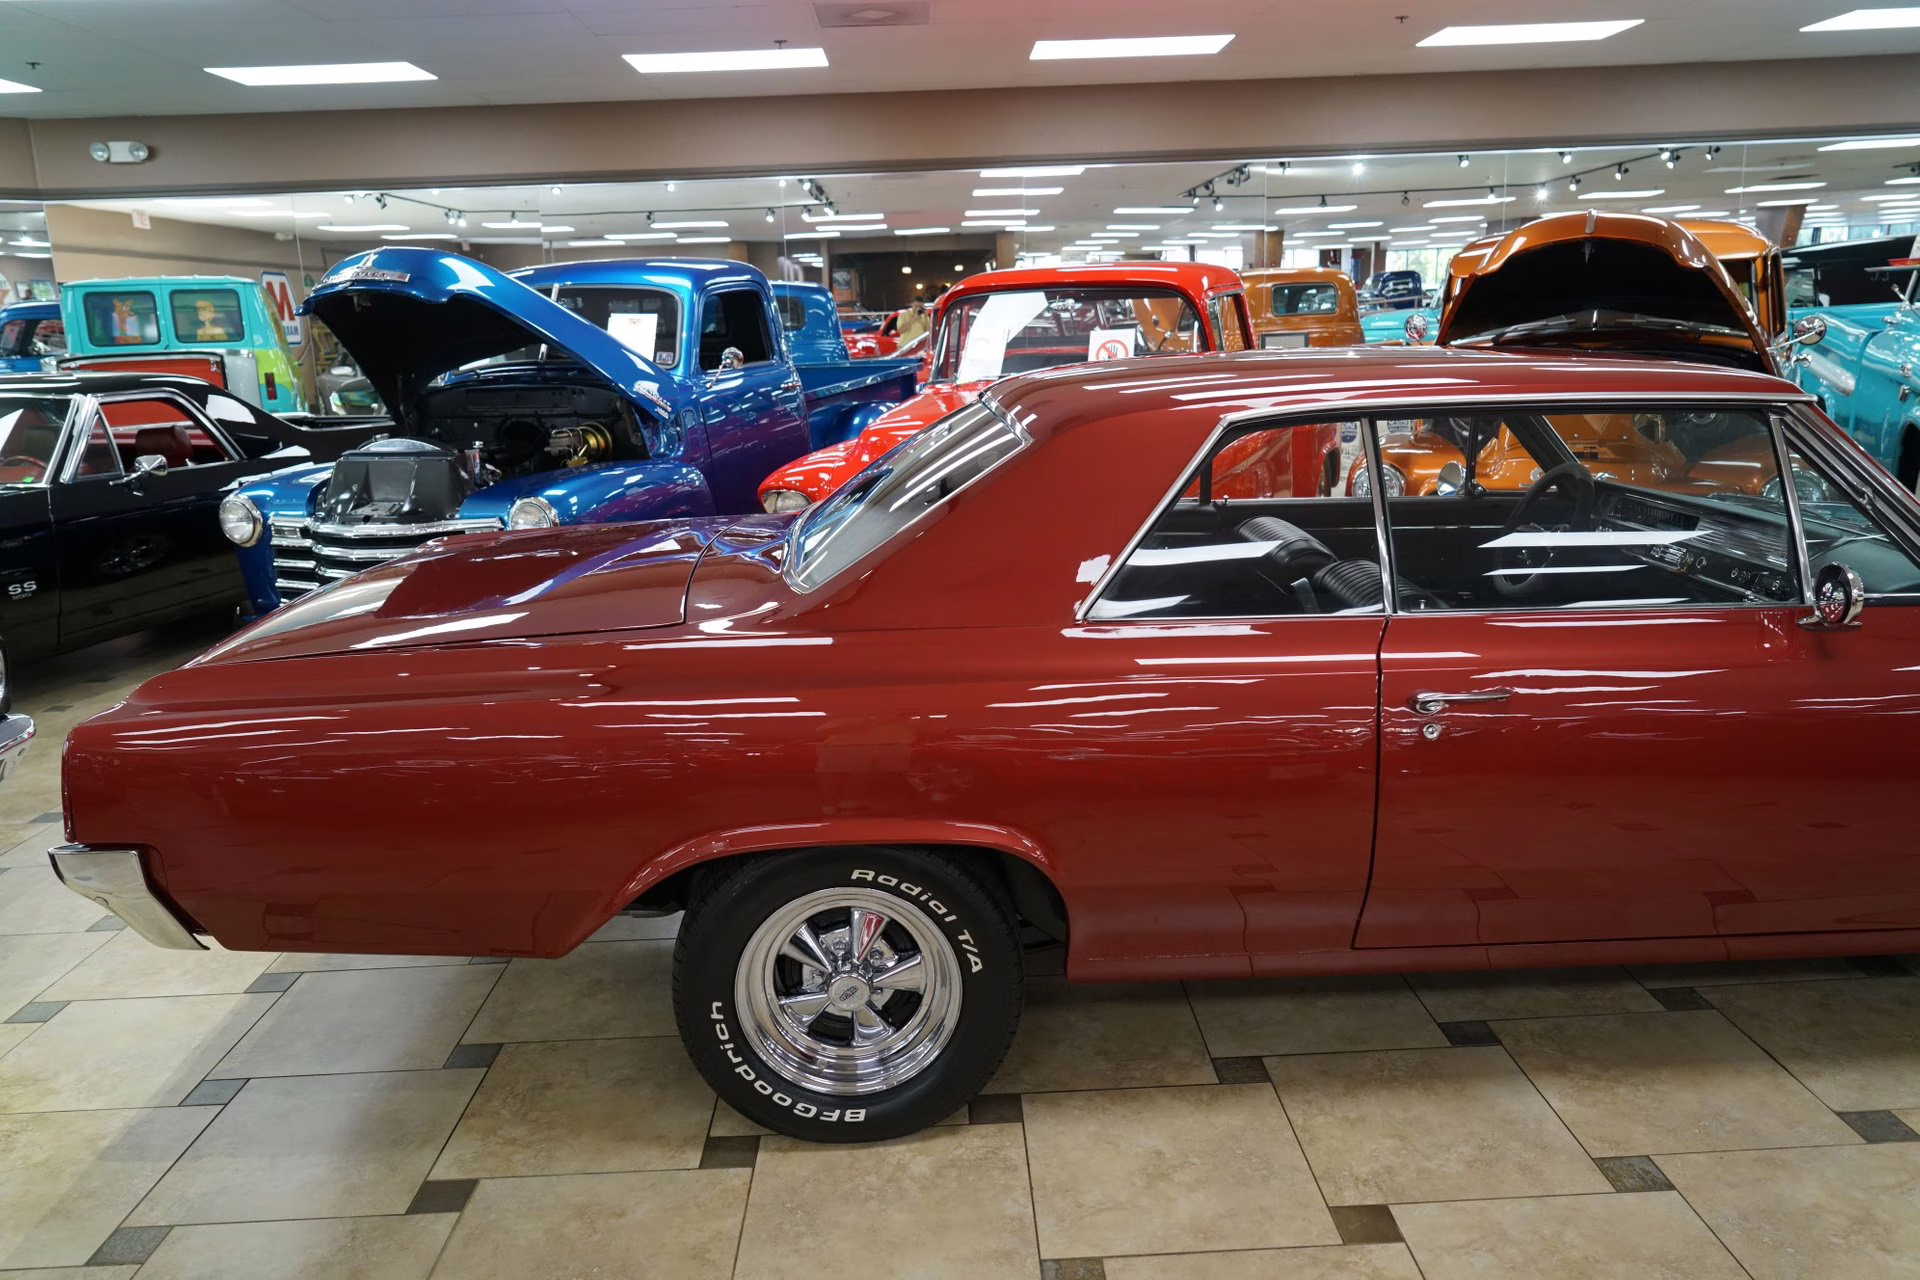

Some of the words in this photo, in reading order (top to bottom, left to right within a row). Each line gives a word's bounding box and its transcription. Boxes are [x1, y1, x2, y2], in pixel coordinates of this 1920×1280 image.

[8, 580, 37, 595] SS
[850, 868, 958, 923] Radial
[957, 929, 983, 973] T/A
[710, 1001, 867, 1123] BFGoodrich
